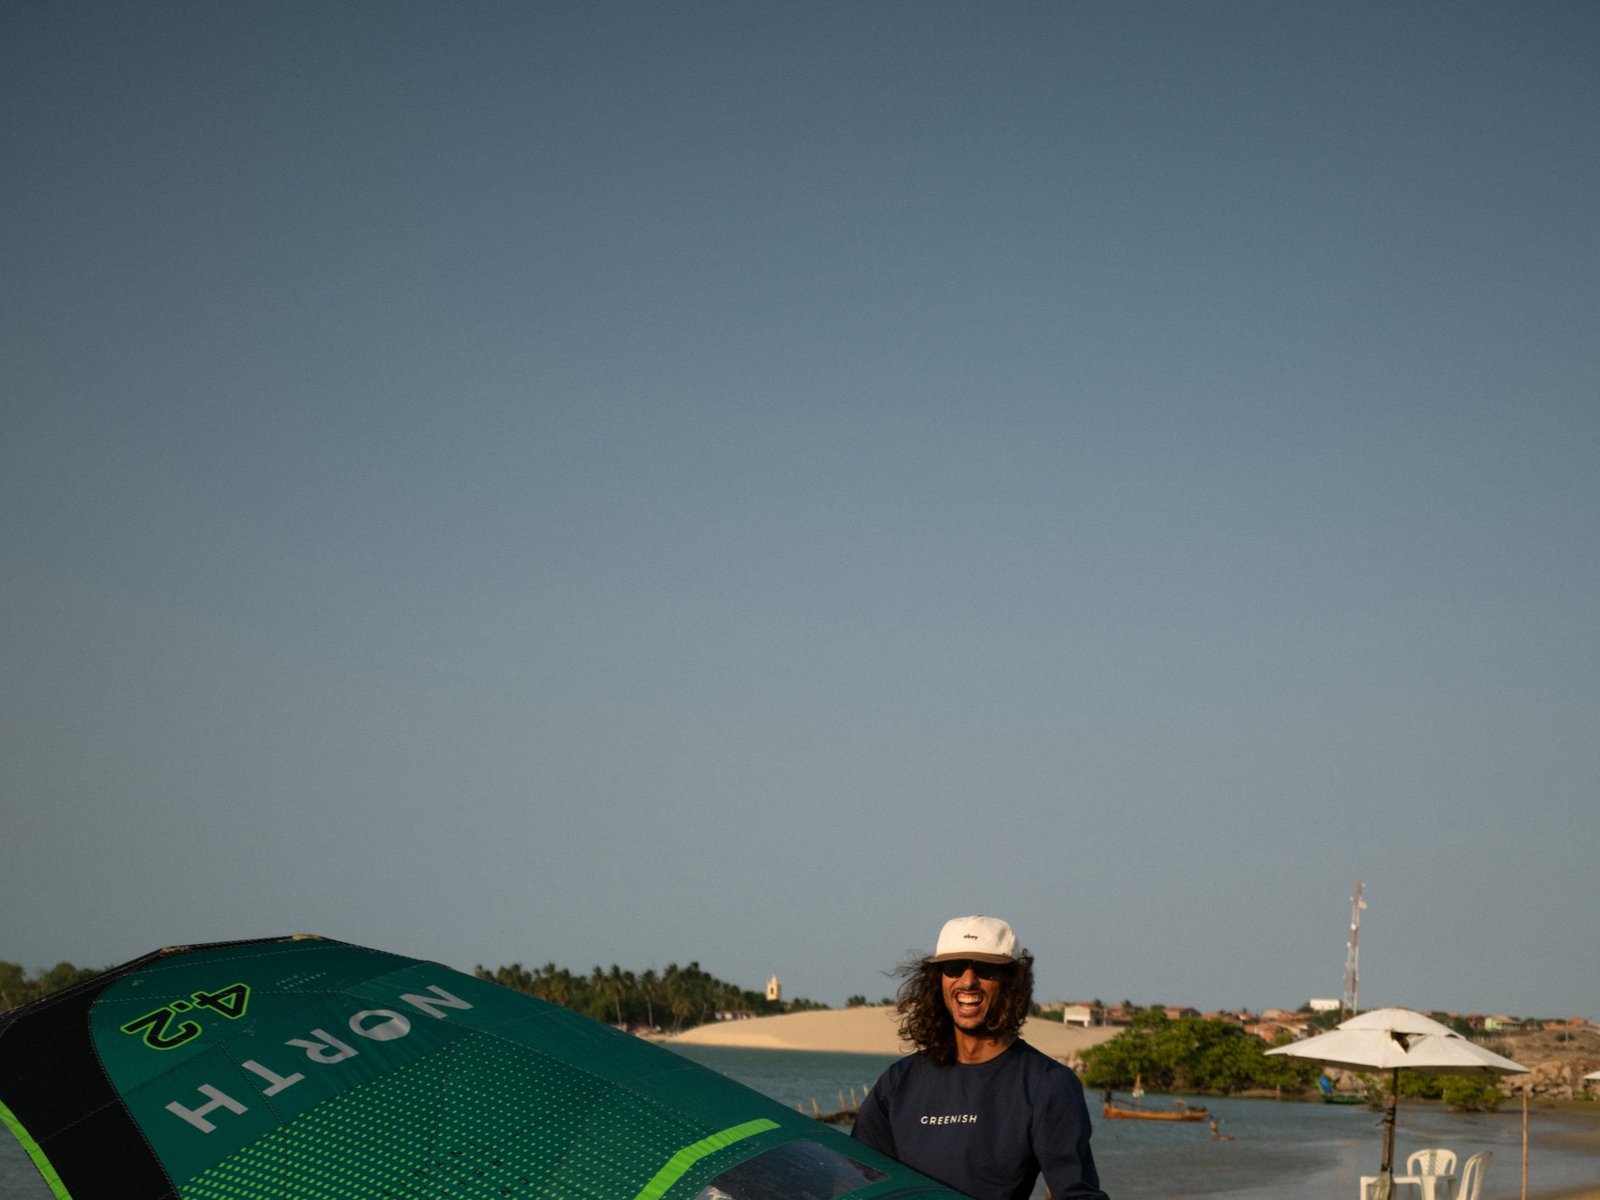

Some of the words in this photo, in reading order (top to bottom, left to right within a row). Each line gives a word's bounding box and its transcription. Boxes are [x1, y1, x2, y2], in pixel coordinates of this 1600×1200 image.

[120, 983, 251, 1051] 4.2
[165, 985, 474, 1133] NORTH
[919, 1114, 978, 1126] GREENISH
